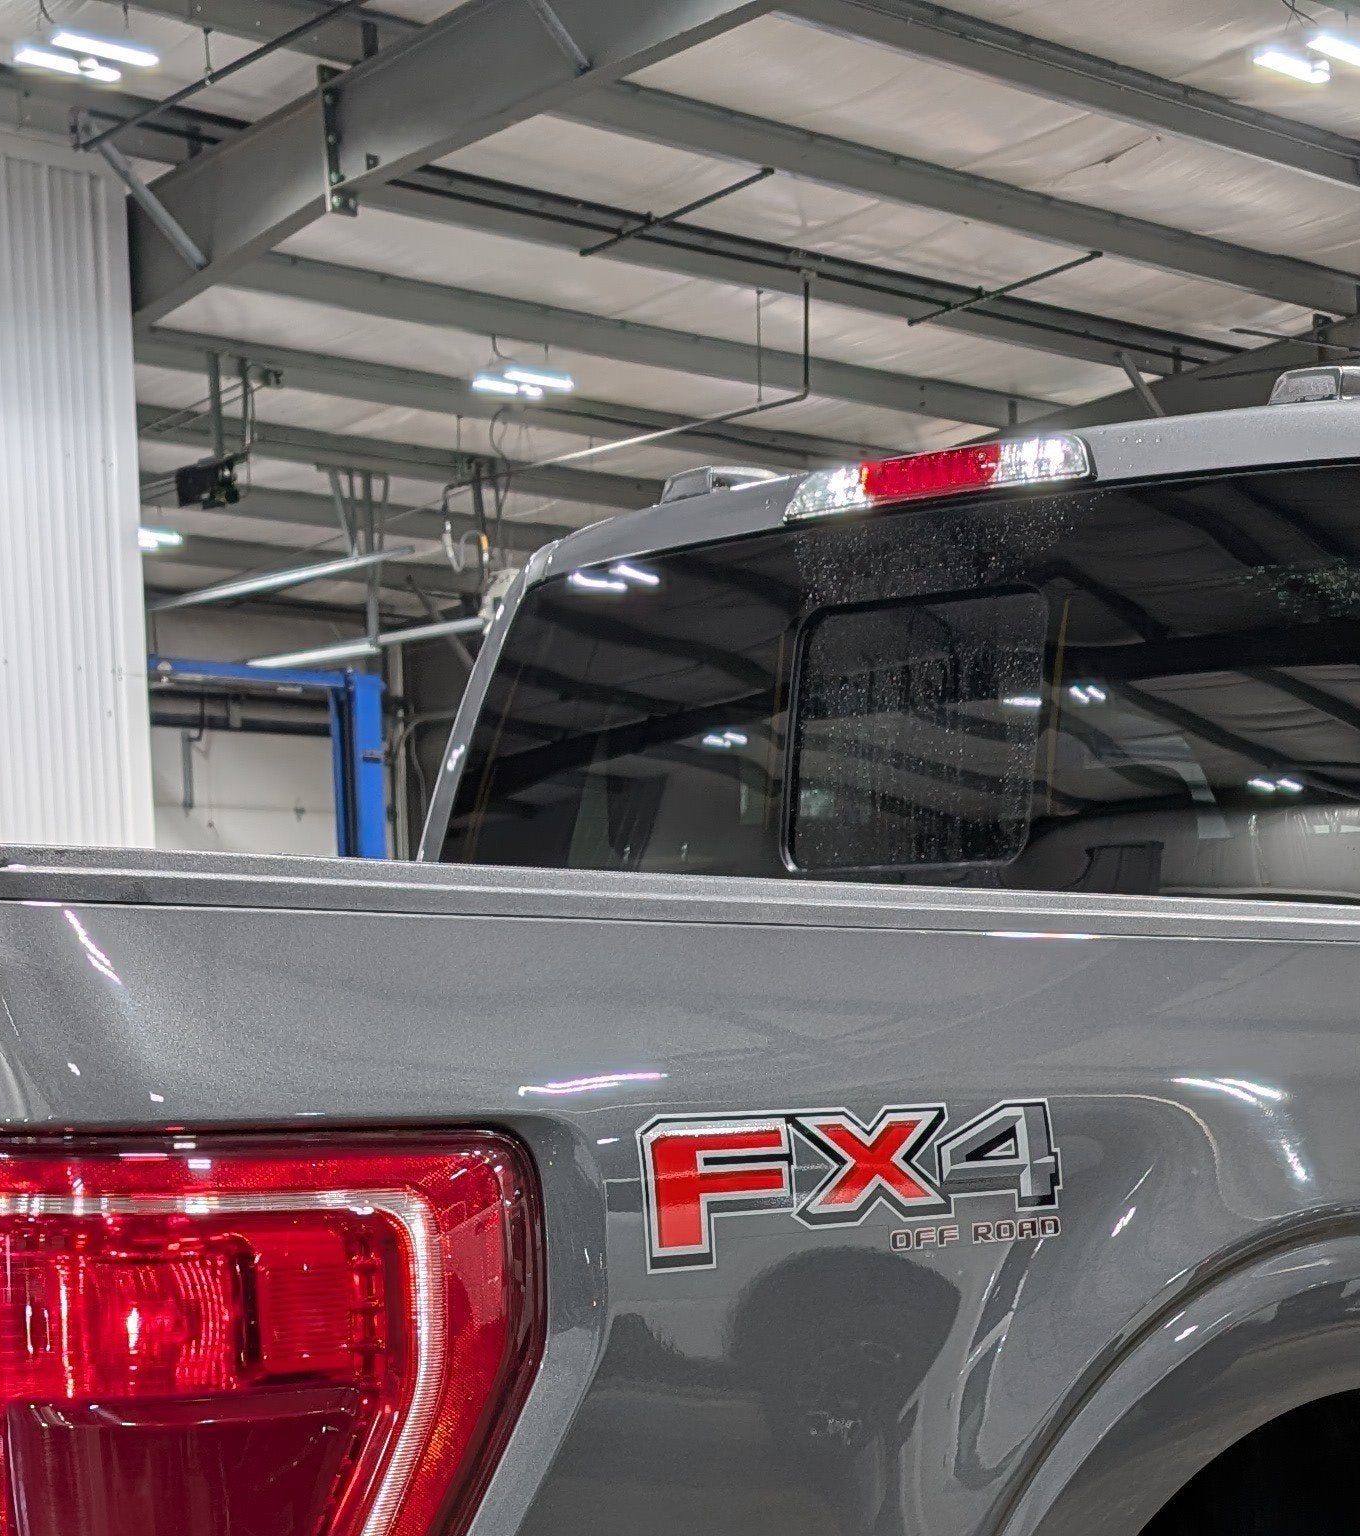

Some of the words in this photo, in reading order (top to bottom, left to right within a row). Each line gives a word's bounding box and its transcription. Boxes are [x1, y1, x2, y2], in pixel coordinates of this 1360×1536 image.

[637, 1098, 1062, 1274] FX4
[890, 1224, 960, 1252] OFF
[972, 1215, 1061, 1244] ROAD
